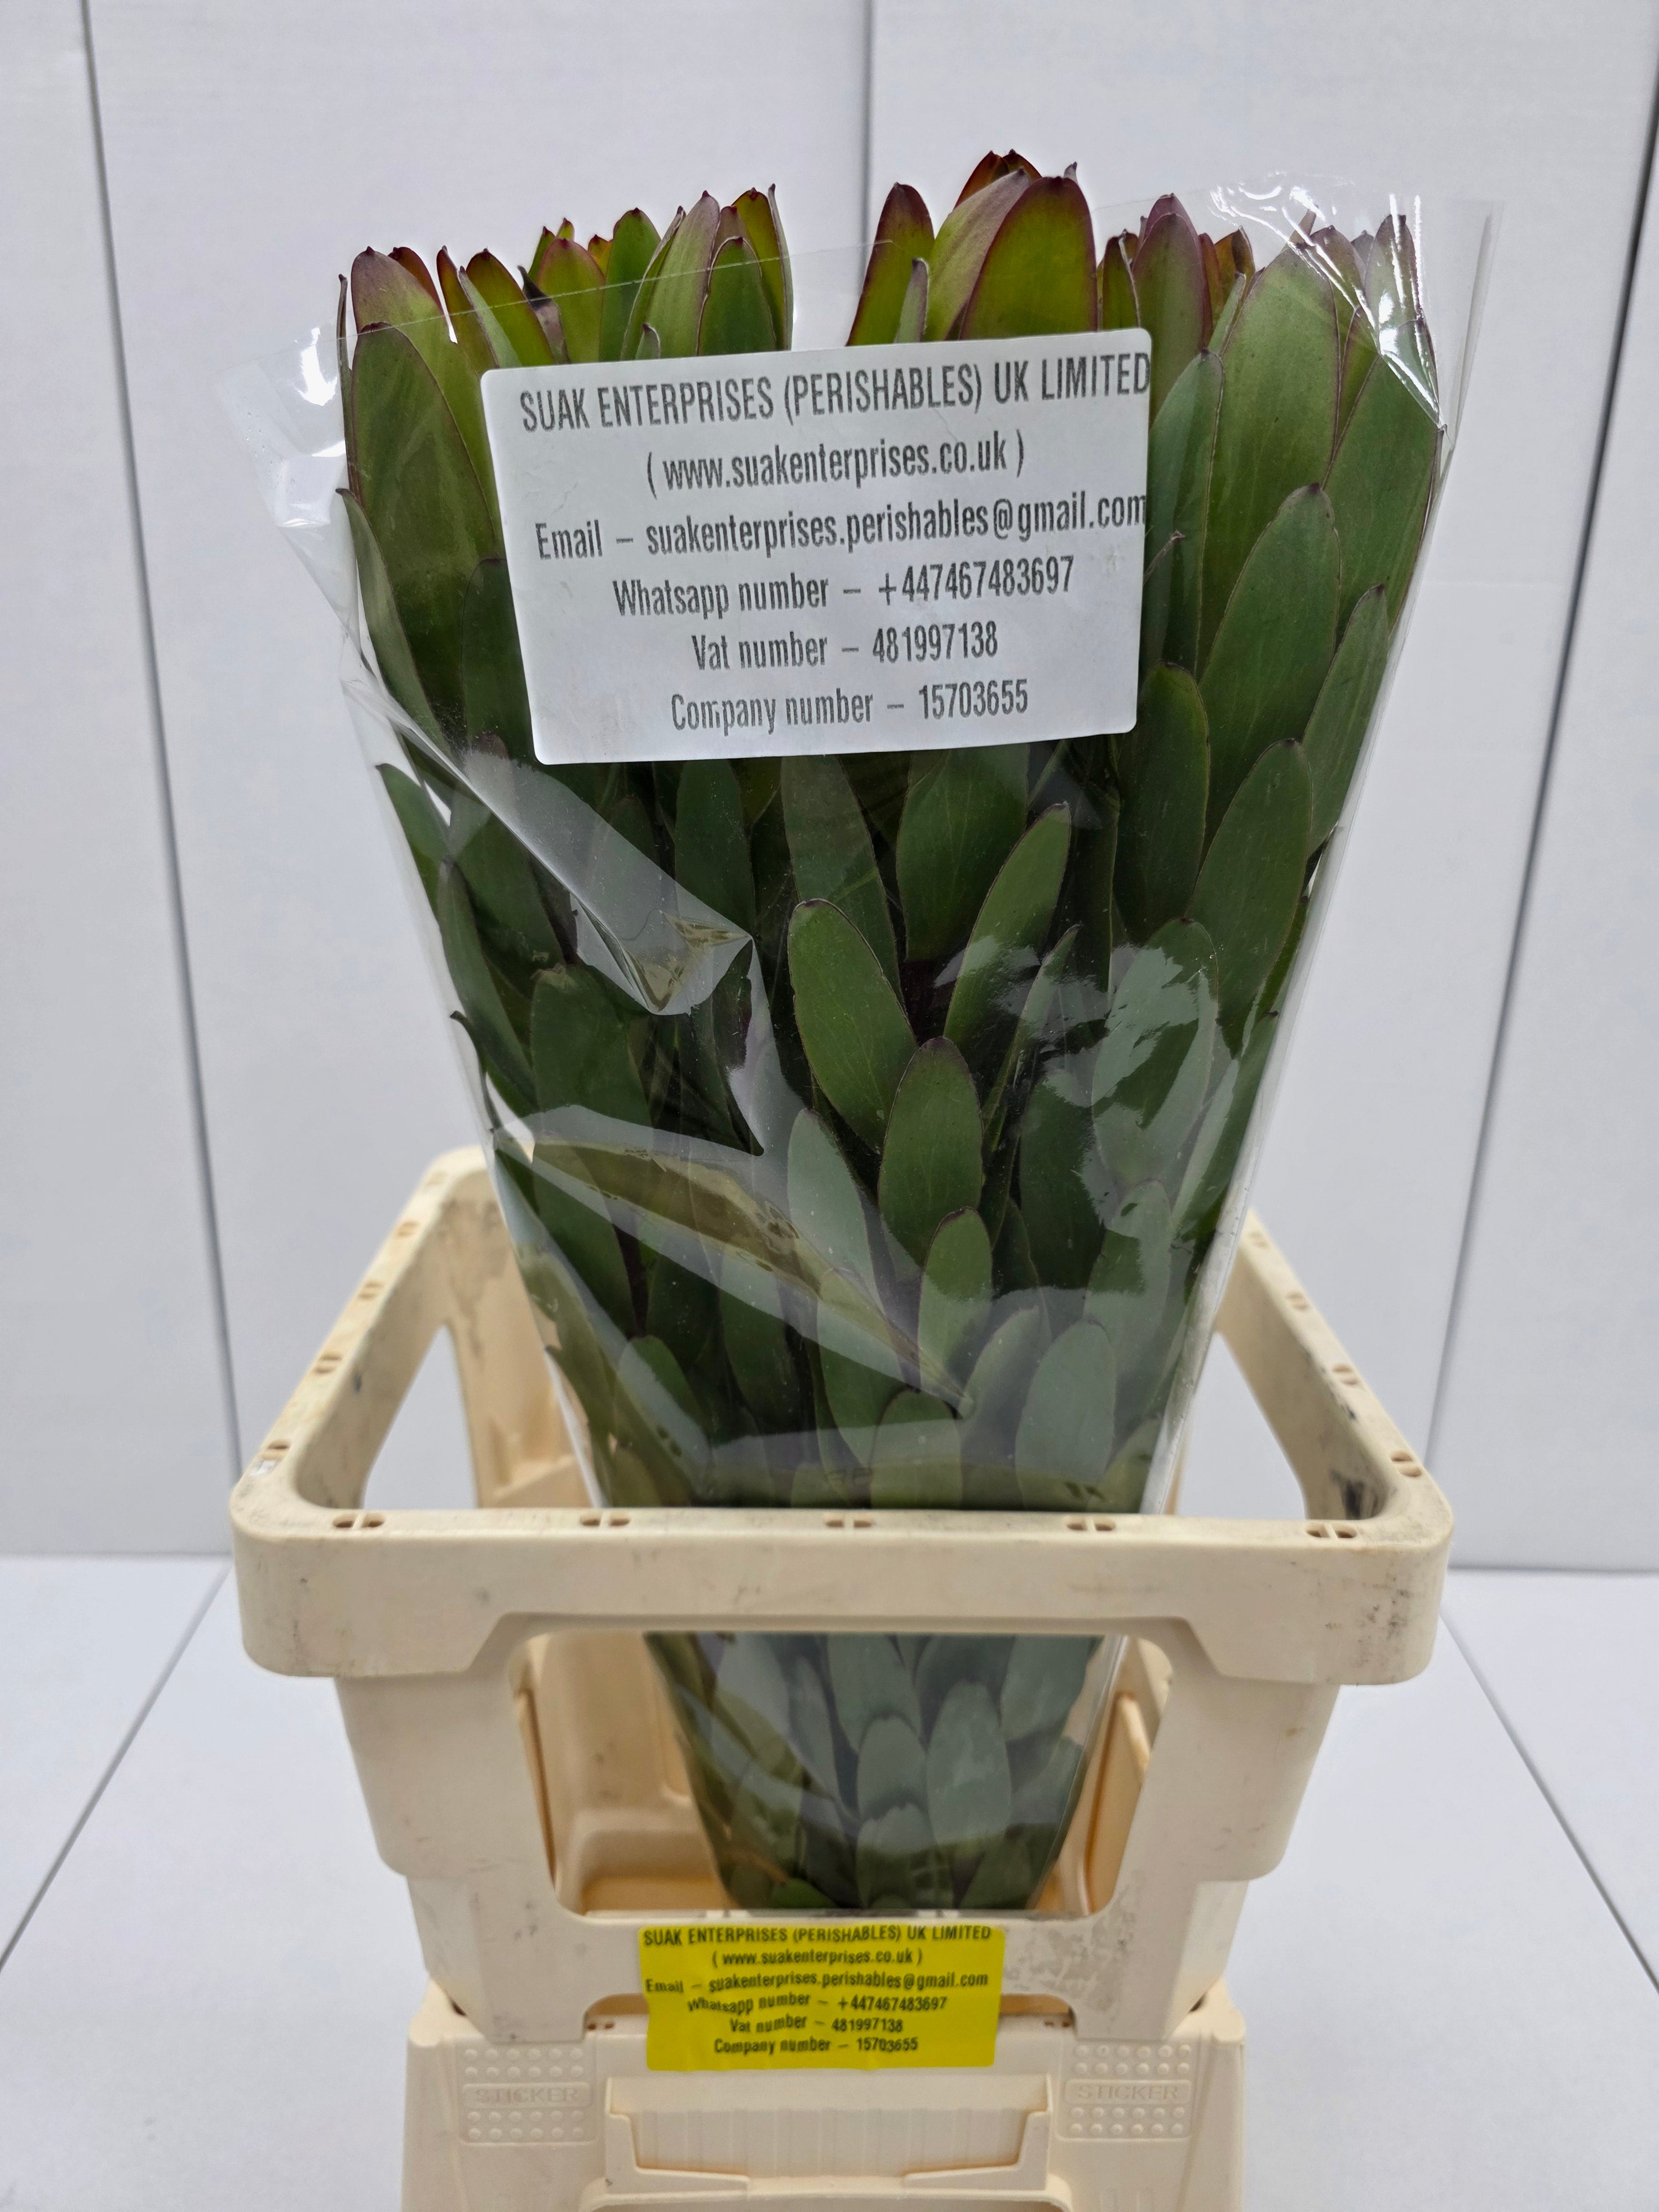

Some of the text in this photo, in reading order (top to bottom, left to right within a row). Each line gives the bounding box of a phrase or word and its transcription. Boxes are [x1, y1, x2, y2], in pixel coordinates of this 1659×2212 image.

[519, 352, 1151, 432] SUAK ENTERPRISES (PERISHABLES) UK LIMITED
[535, 519, 603, 560] Email
[612, 579, 729, 620] Whatsapp
[738, 572, 829, 612] number
[878, 555, 1074, 606] +447467483697
[691, 634, 730, 670] Vat
[738, 630, 828, 669] number
[872, 620, 998, 663] 481997138
[671, 693, 776, 737] Company
[785, 687, 873, 726] number
[918, 679, 1028, 719] 15703655
[644, 1925, 992, 1947] SUAK ENTERPRISES (PERISHABLES) UK LIMITED
[645, 1979, 684, 1993] Email
[687, 1997, 754, 2016] Whatsapp
[758, 1991, 810, 2010] number
[838, 1995, 947, 2012] +447467483697
[729, 2018, 751, 2033] Vat
[756, 2013, 807, 2033] number
[831, 2017, 903, 2033] 481997138
[714, 2038, 775, 2056] Company
[780, 2037, 831, 2052] number
[857, 2037, 919, 2053] 15703655
[474, 2087, 578, 2103] STICKER
[1077, 2084, 1179, 2100] STICKER
